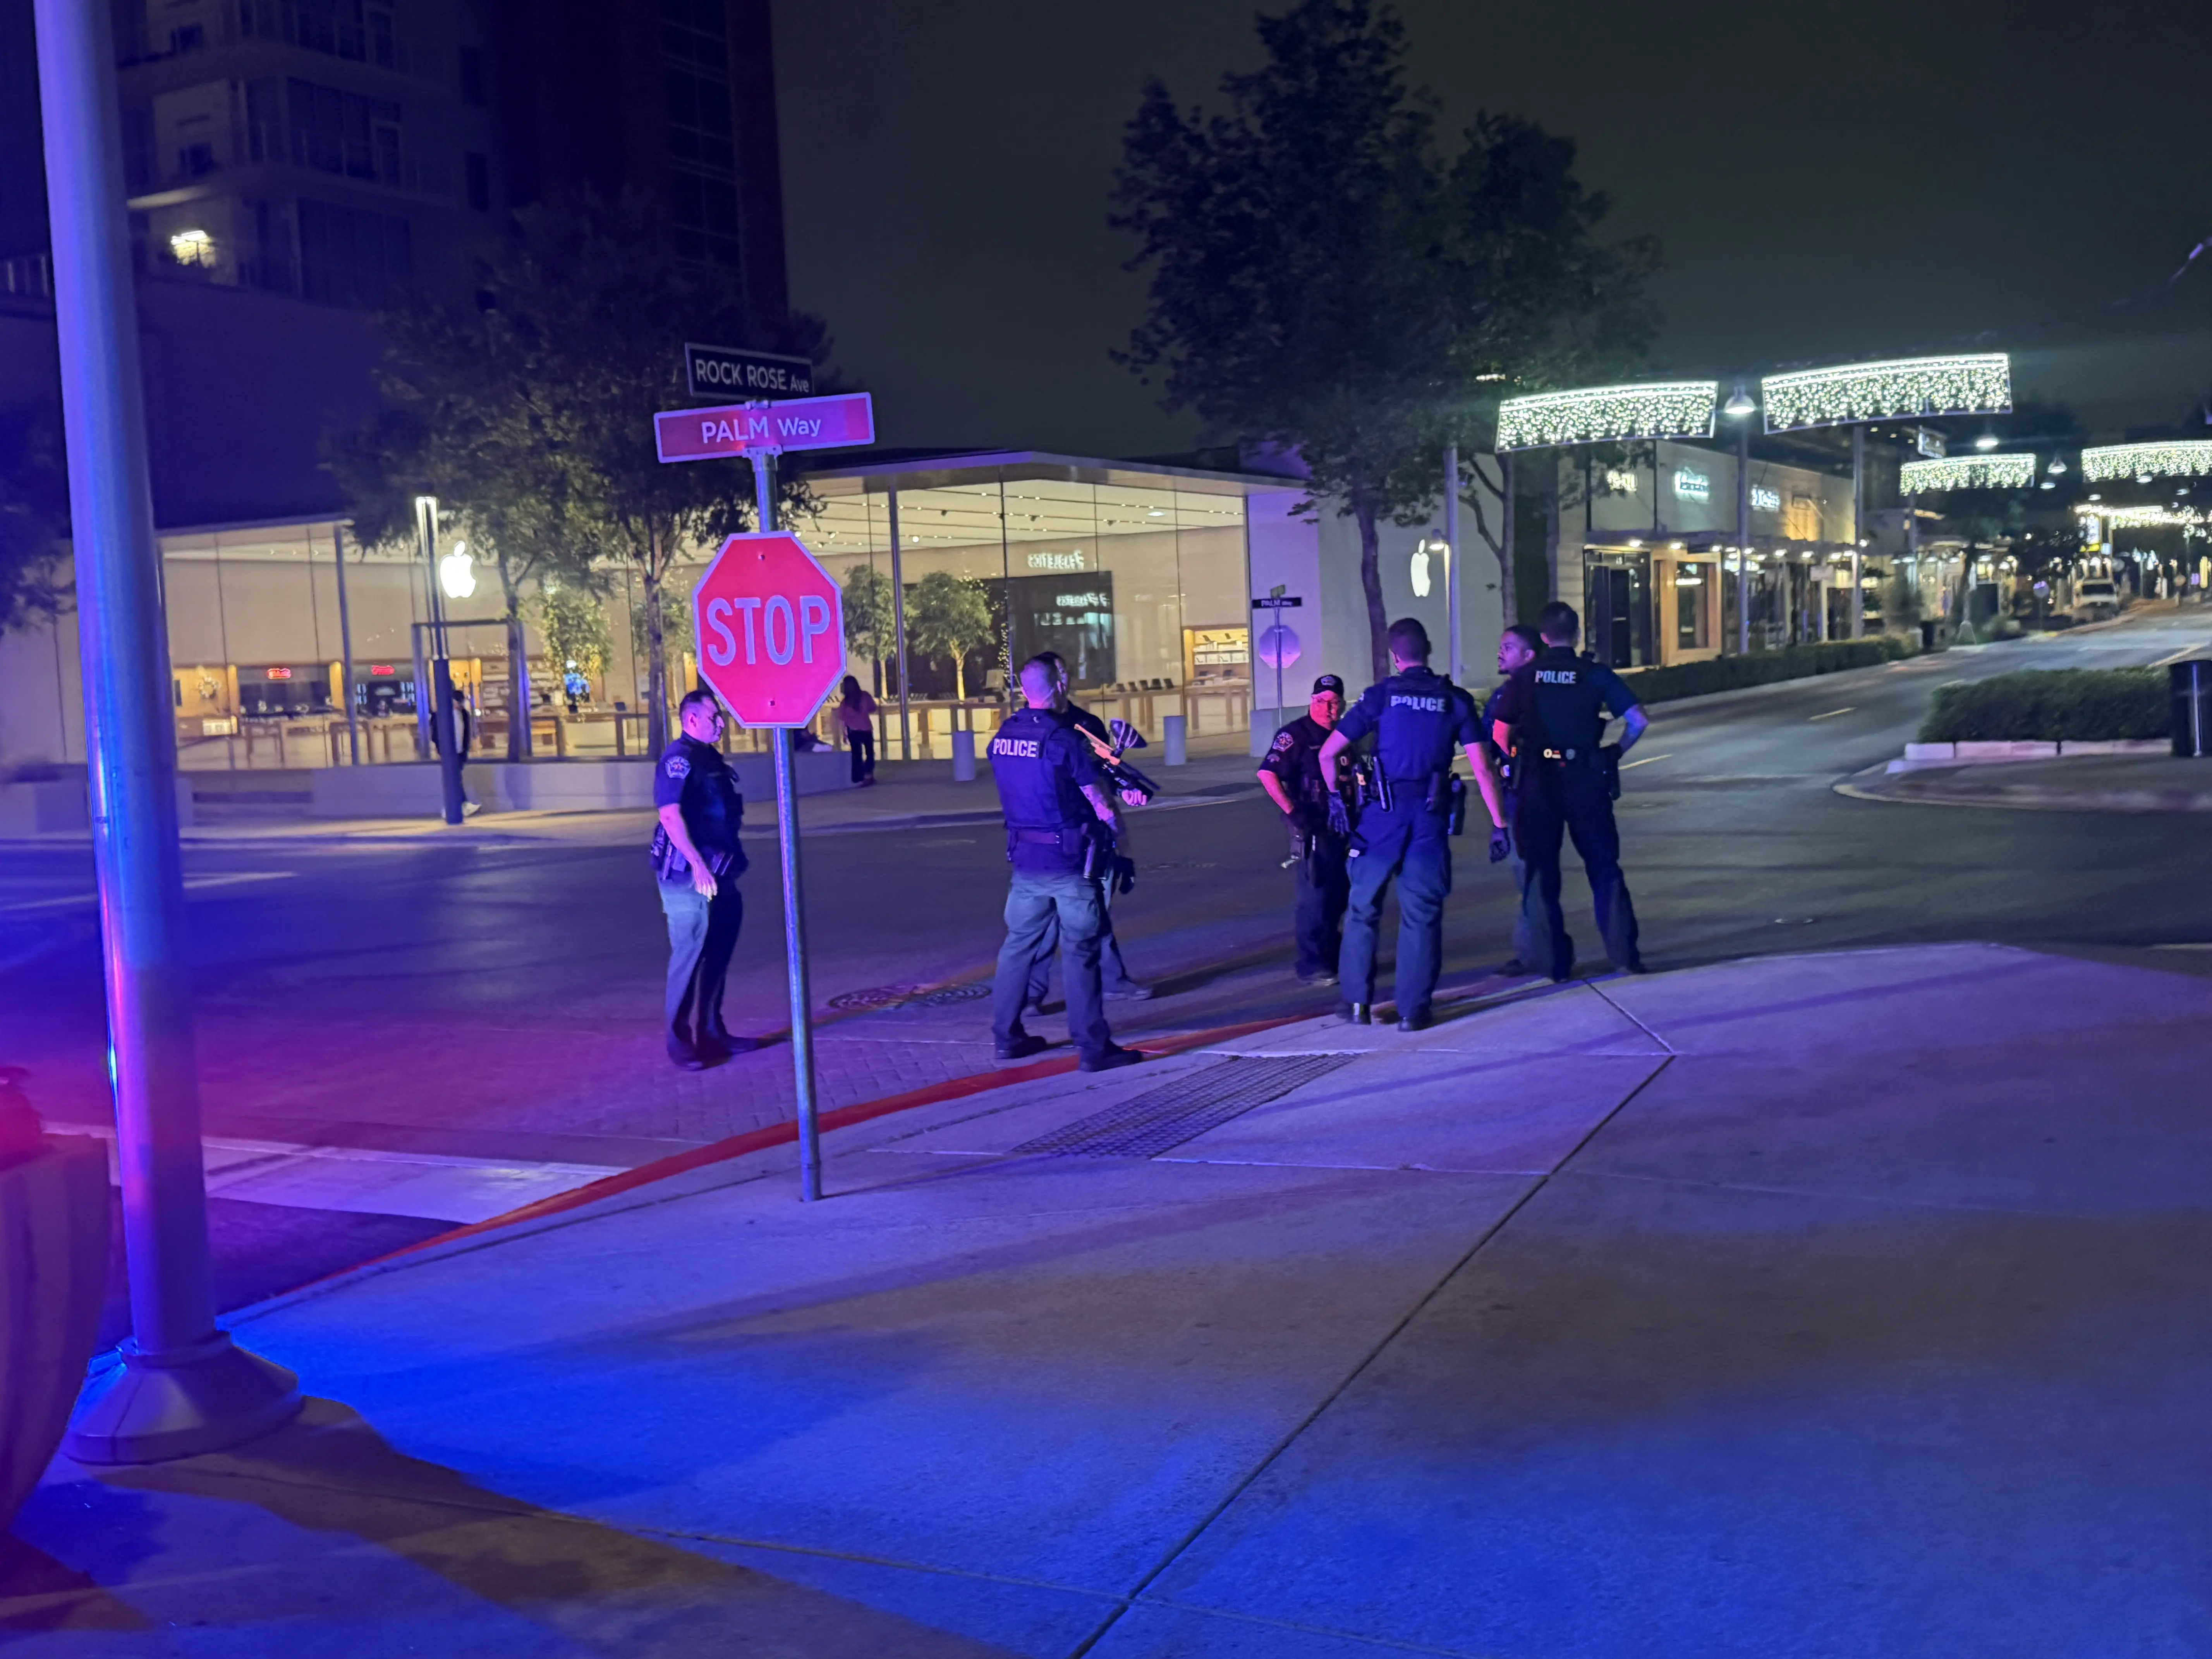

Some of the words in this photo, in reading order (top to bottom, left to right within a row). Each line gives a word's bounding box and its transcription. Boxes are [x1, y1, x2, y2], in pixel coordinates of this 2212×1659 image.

[696, 359, 742, 386] ROCK
[747, 365, 787, 390] ROSE
[790, 375, 809, 393] Ave
[701, 416, 769, 443] PALM
[777, 417, 821, 437] Way
[708, 595, 830, 665] STOP
[1535, 670, 1576, 684] POLICE
[1391, 696, 1445, 712] POLICE
[993, 738, 1038, 757] POLICE
